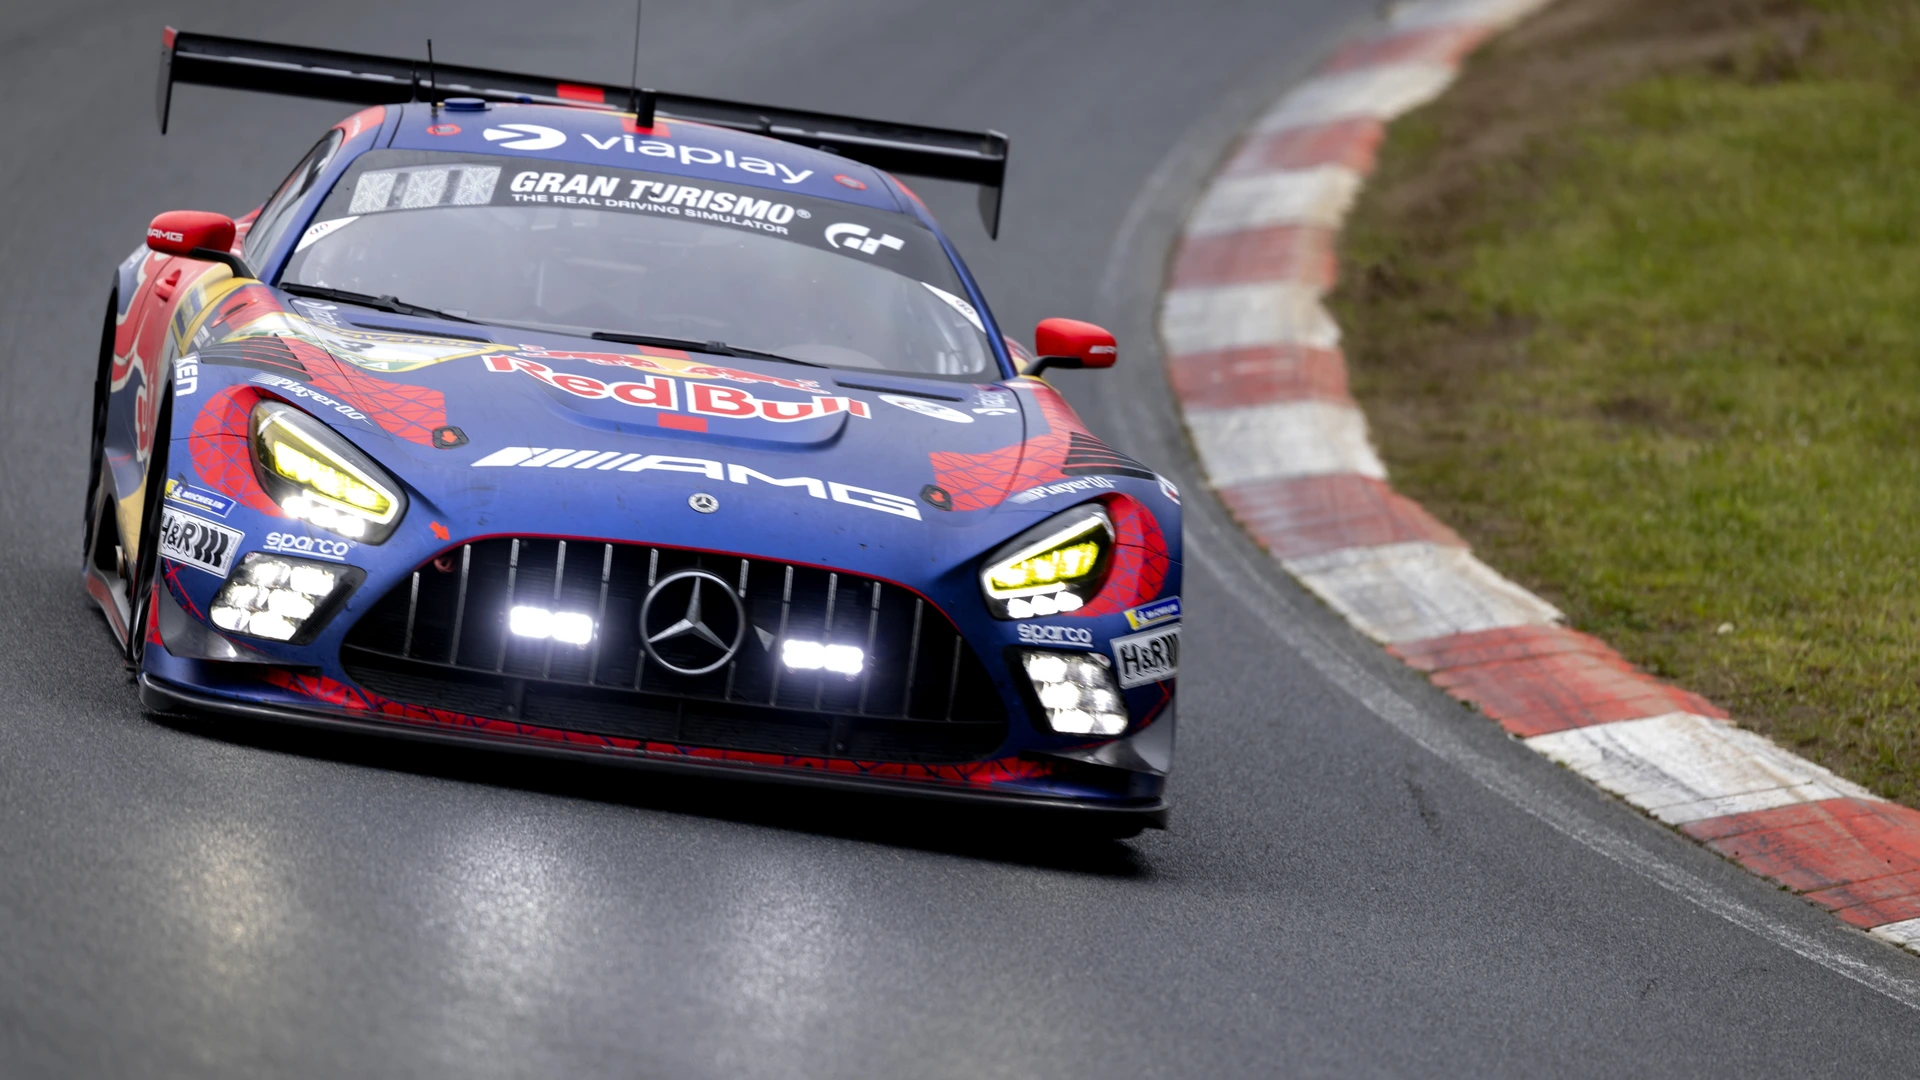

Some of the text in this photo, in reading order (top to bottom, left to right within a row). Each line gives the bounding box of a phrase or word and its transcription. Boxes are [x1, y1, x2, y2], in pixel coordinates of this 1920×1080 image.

[581, 133, 814, 184] viaplay
[510, 171, 621, 197] GRAN
[512, 194, 789, 235] THE REAL DRIVING SIMULATOR
[150, 228, 184, 243] AMG
[480, 354, 679, 412] Red
[687, 381, 872, 423] Bull
[181, 490, 226, 510] MICHELIN
[618, 453, 923, 522] AMG
[161, 513, 197, 552] H&R
[265, 531, 349, 557] sparco
[1016, 623, 1093, 644] sparco
[1119, 639, 1167, 676] H&R
